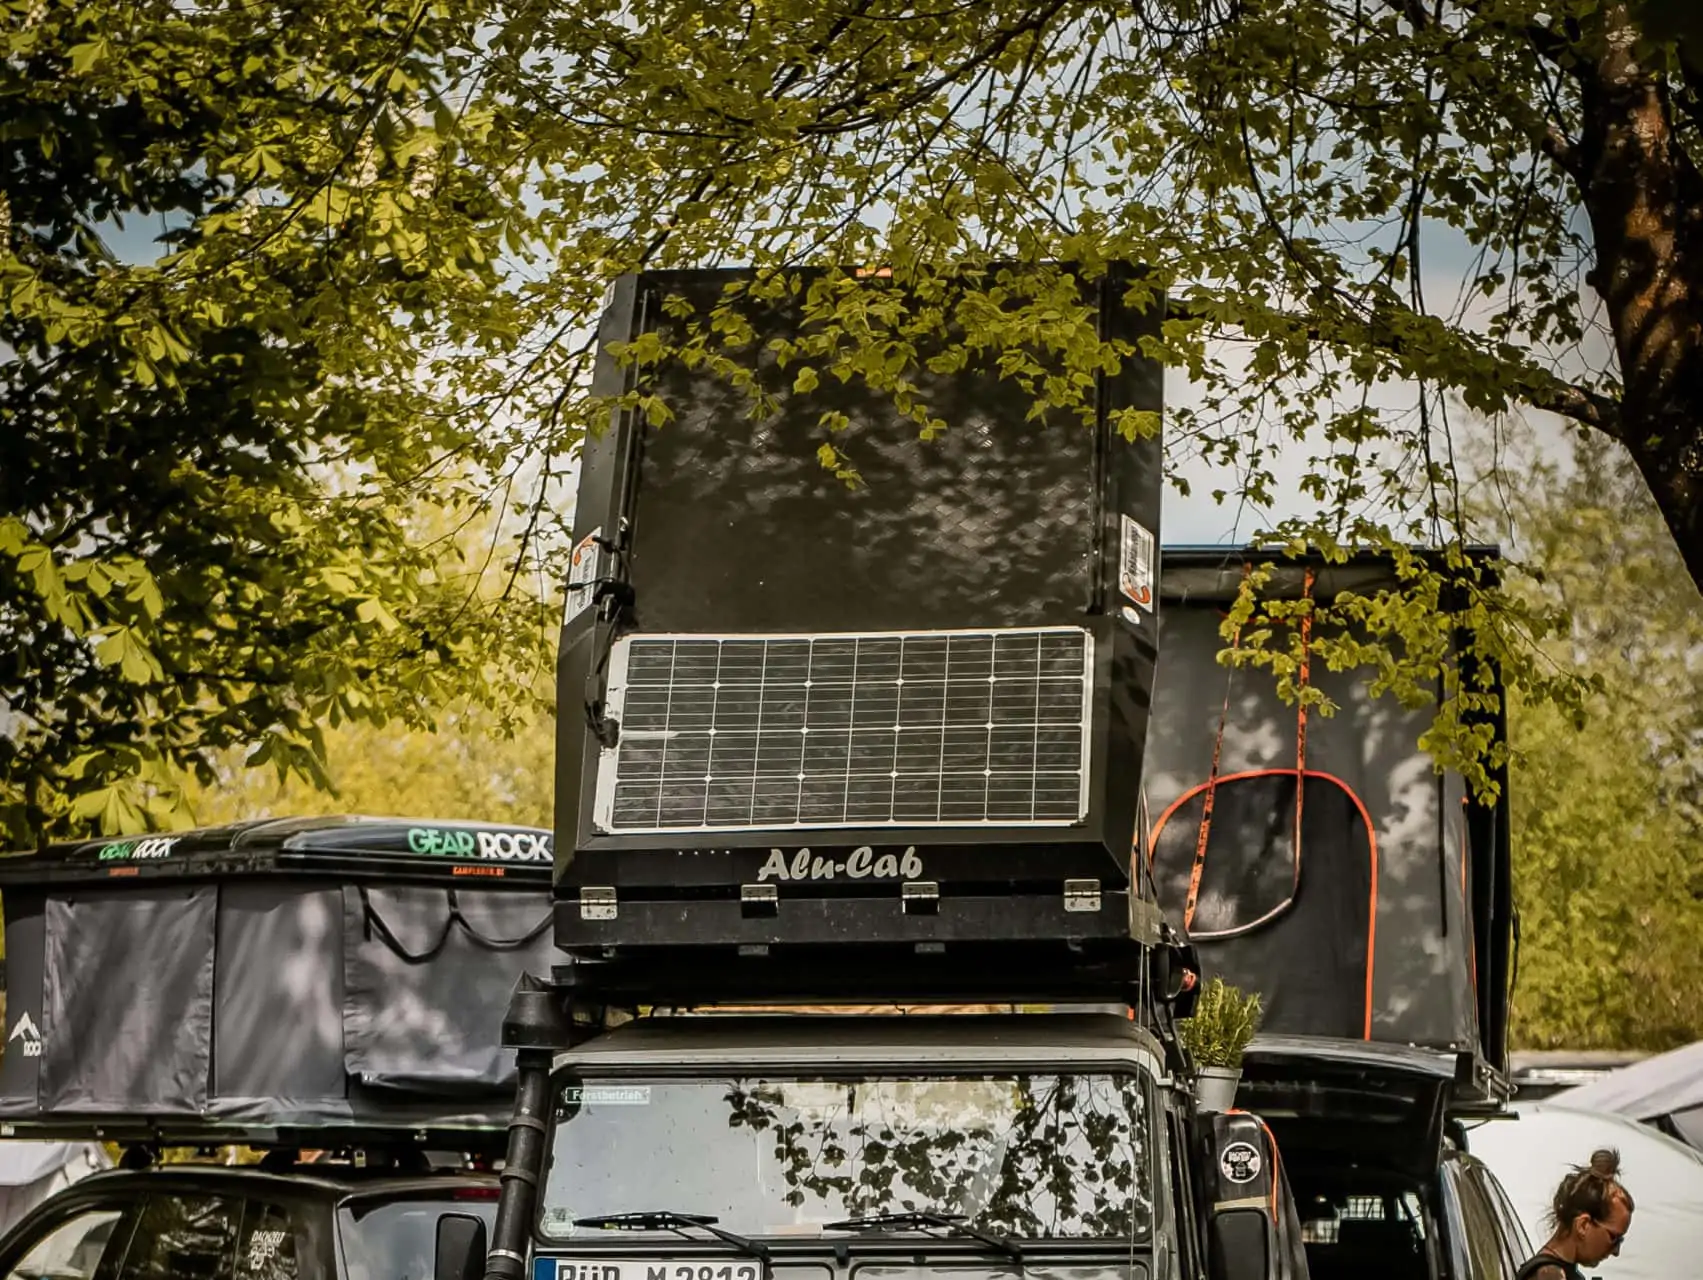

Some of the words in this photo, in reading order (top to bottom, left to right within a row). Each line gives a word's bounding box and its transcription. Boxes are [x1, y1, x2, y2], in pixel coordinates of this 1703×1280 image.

[99, 840, 136, 859] GEAR
[131, 837, 181, 859] ROCK
[408, 828, 475, 857] GEAR
[477, 831, 554, 860] ROCK
[757, 846, 922, 881] Alu-Cab
